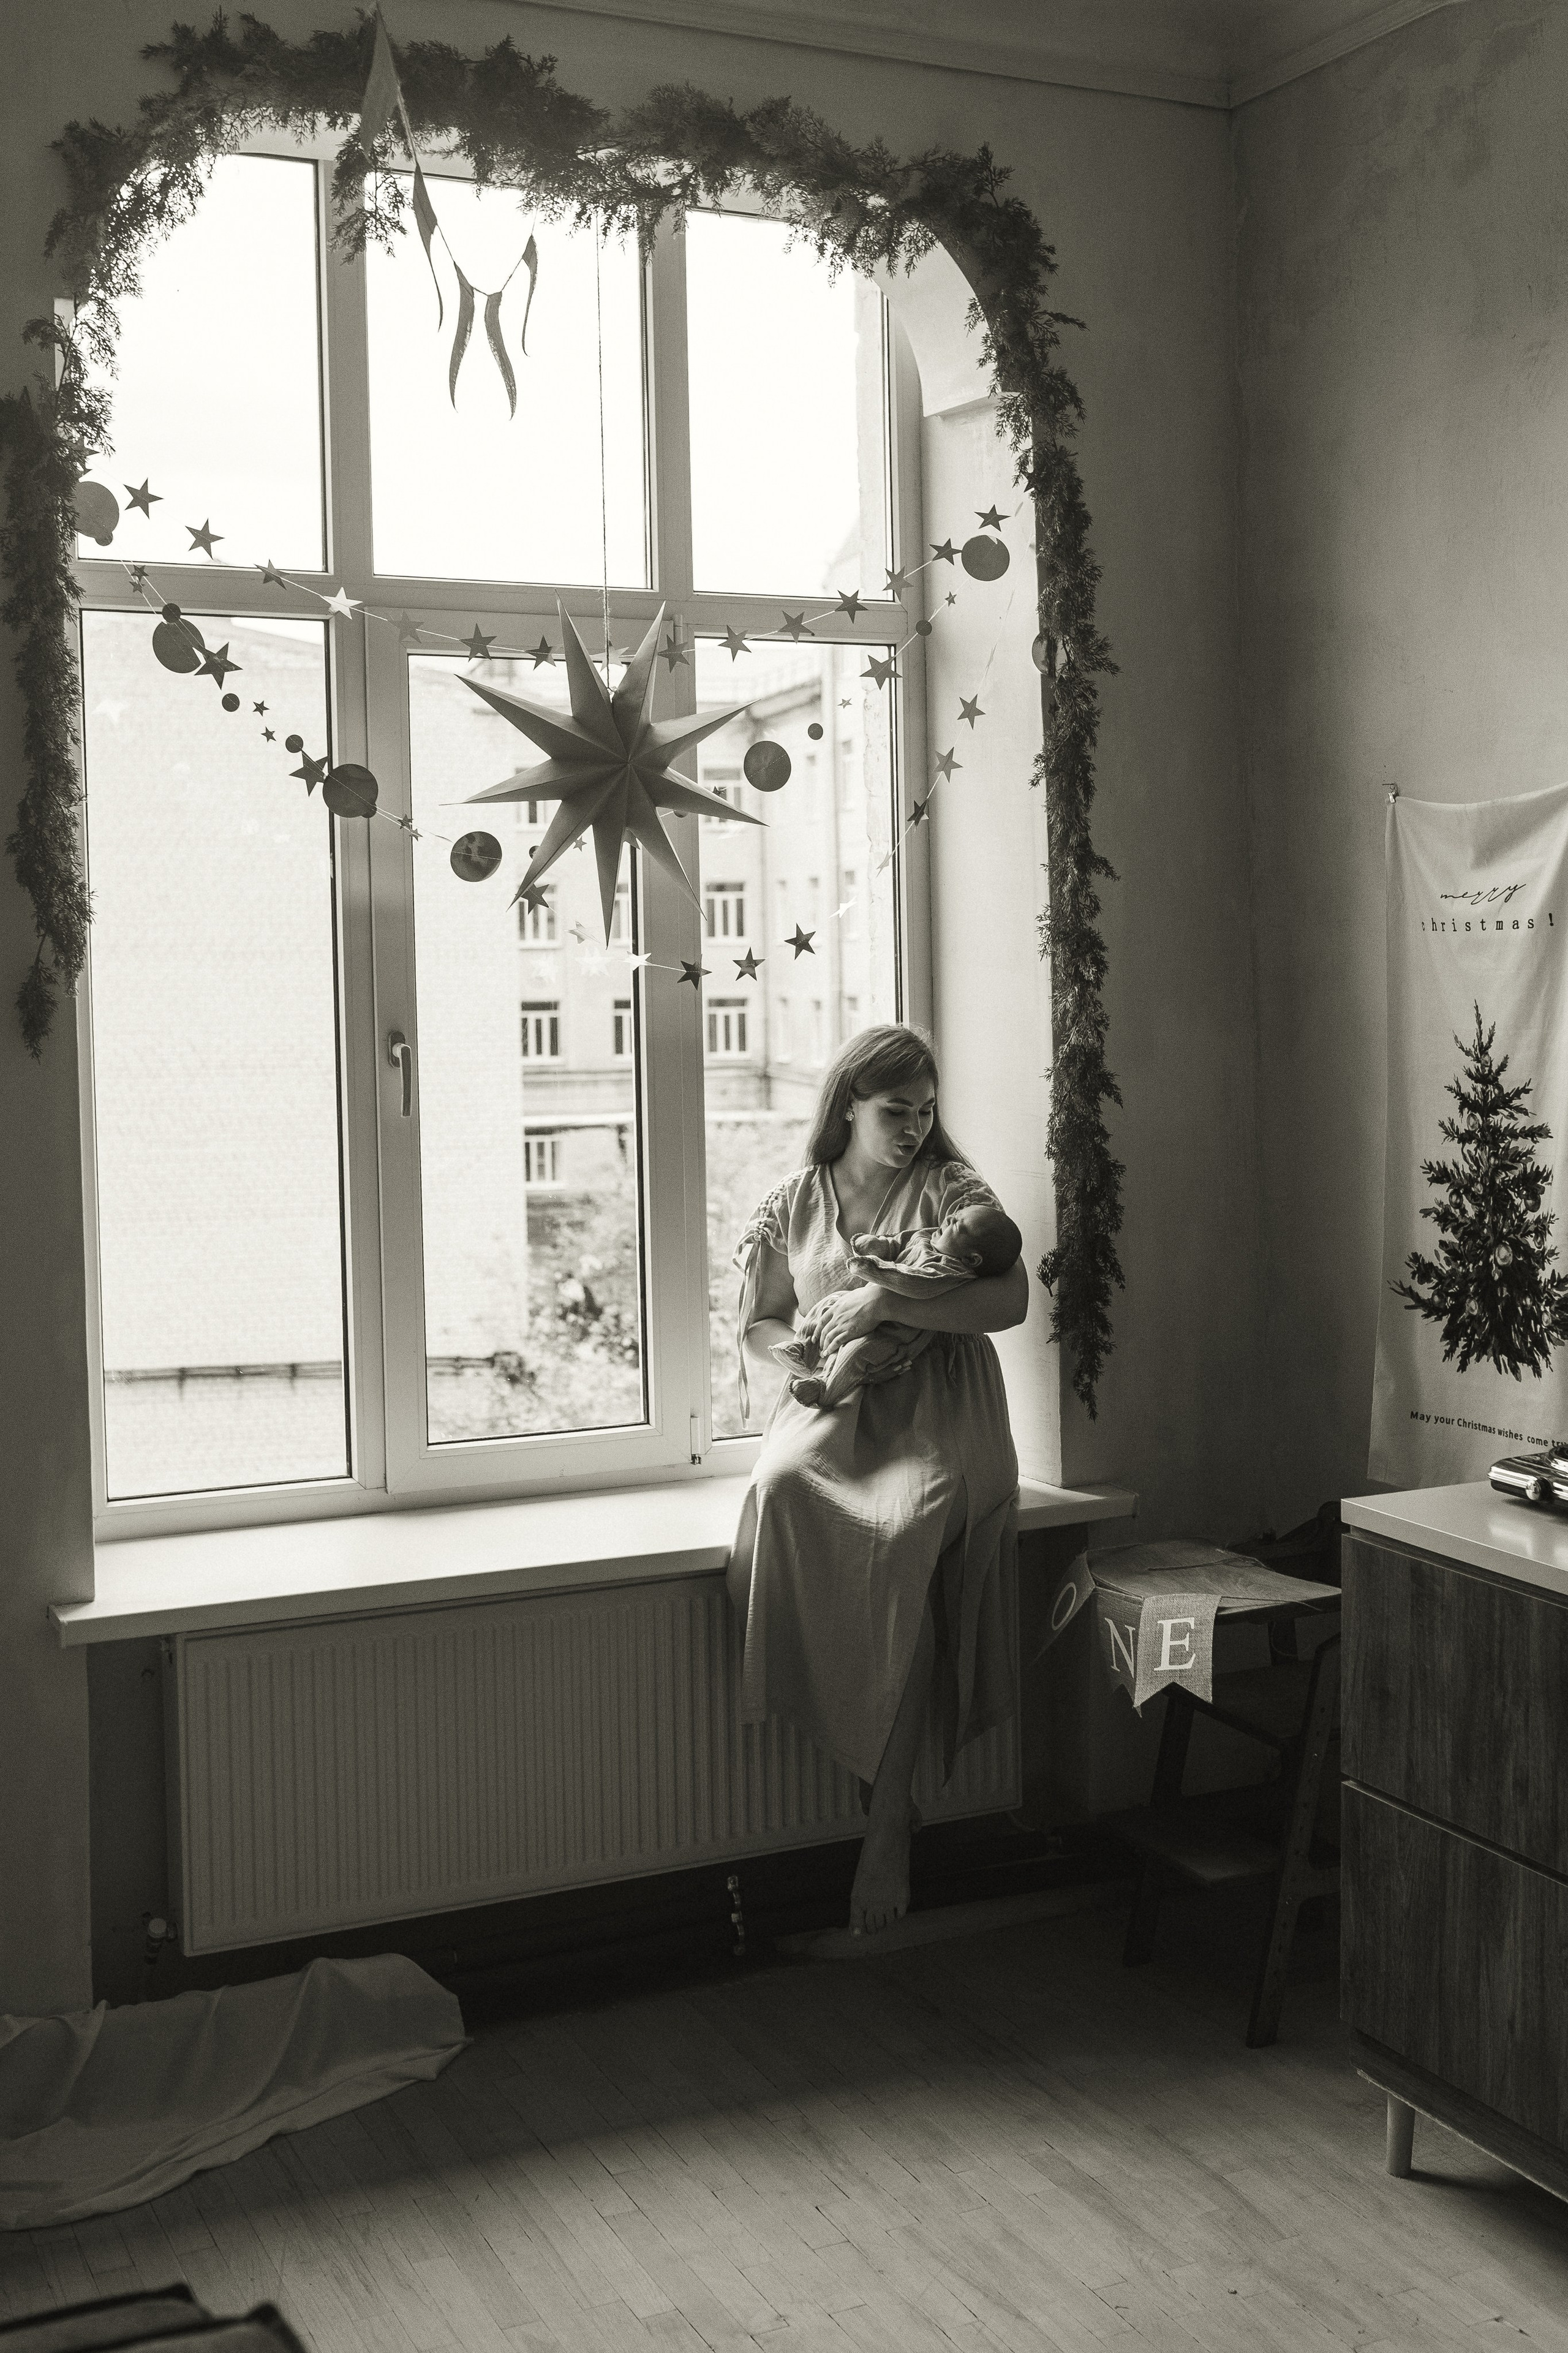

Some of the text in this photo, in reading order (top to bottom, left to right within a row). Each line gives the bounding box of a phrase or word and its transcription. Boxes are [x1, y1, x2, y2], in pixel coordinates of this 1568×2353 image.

[1440, 883, 1526, 905] merry
[1410, 1411, 1431, 1423] May
[1434, 1415, 1455, 1425] your
[1457, 1418, 1496, 1435] Christmas
[1497, 1428, 1523, 1441] wishes
[1527, 1435, 1548, 1446] come
